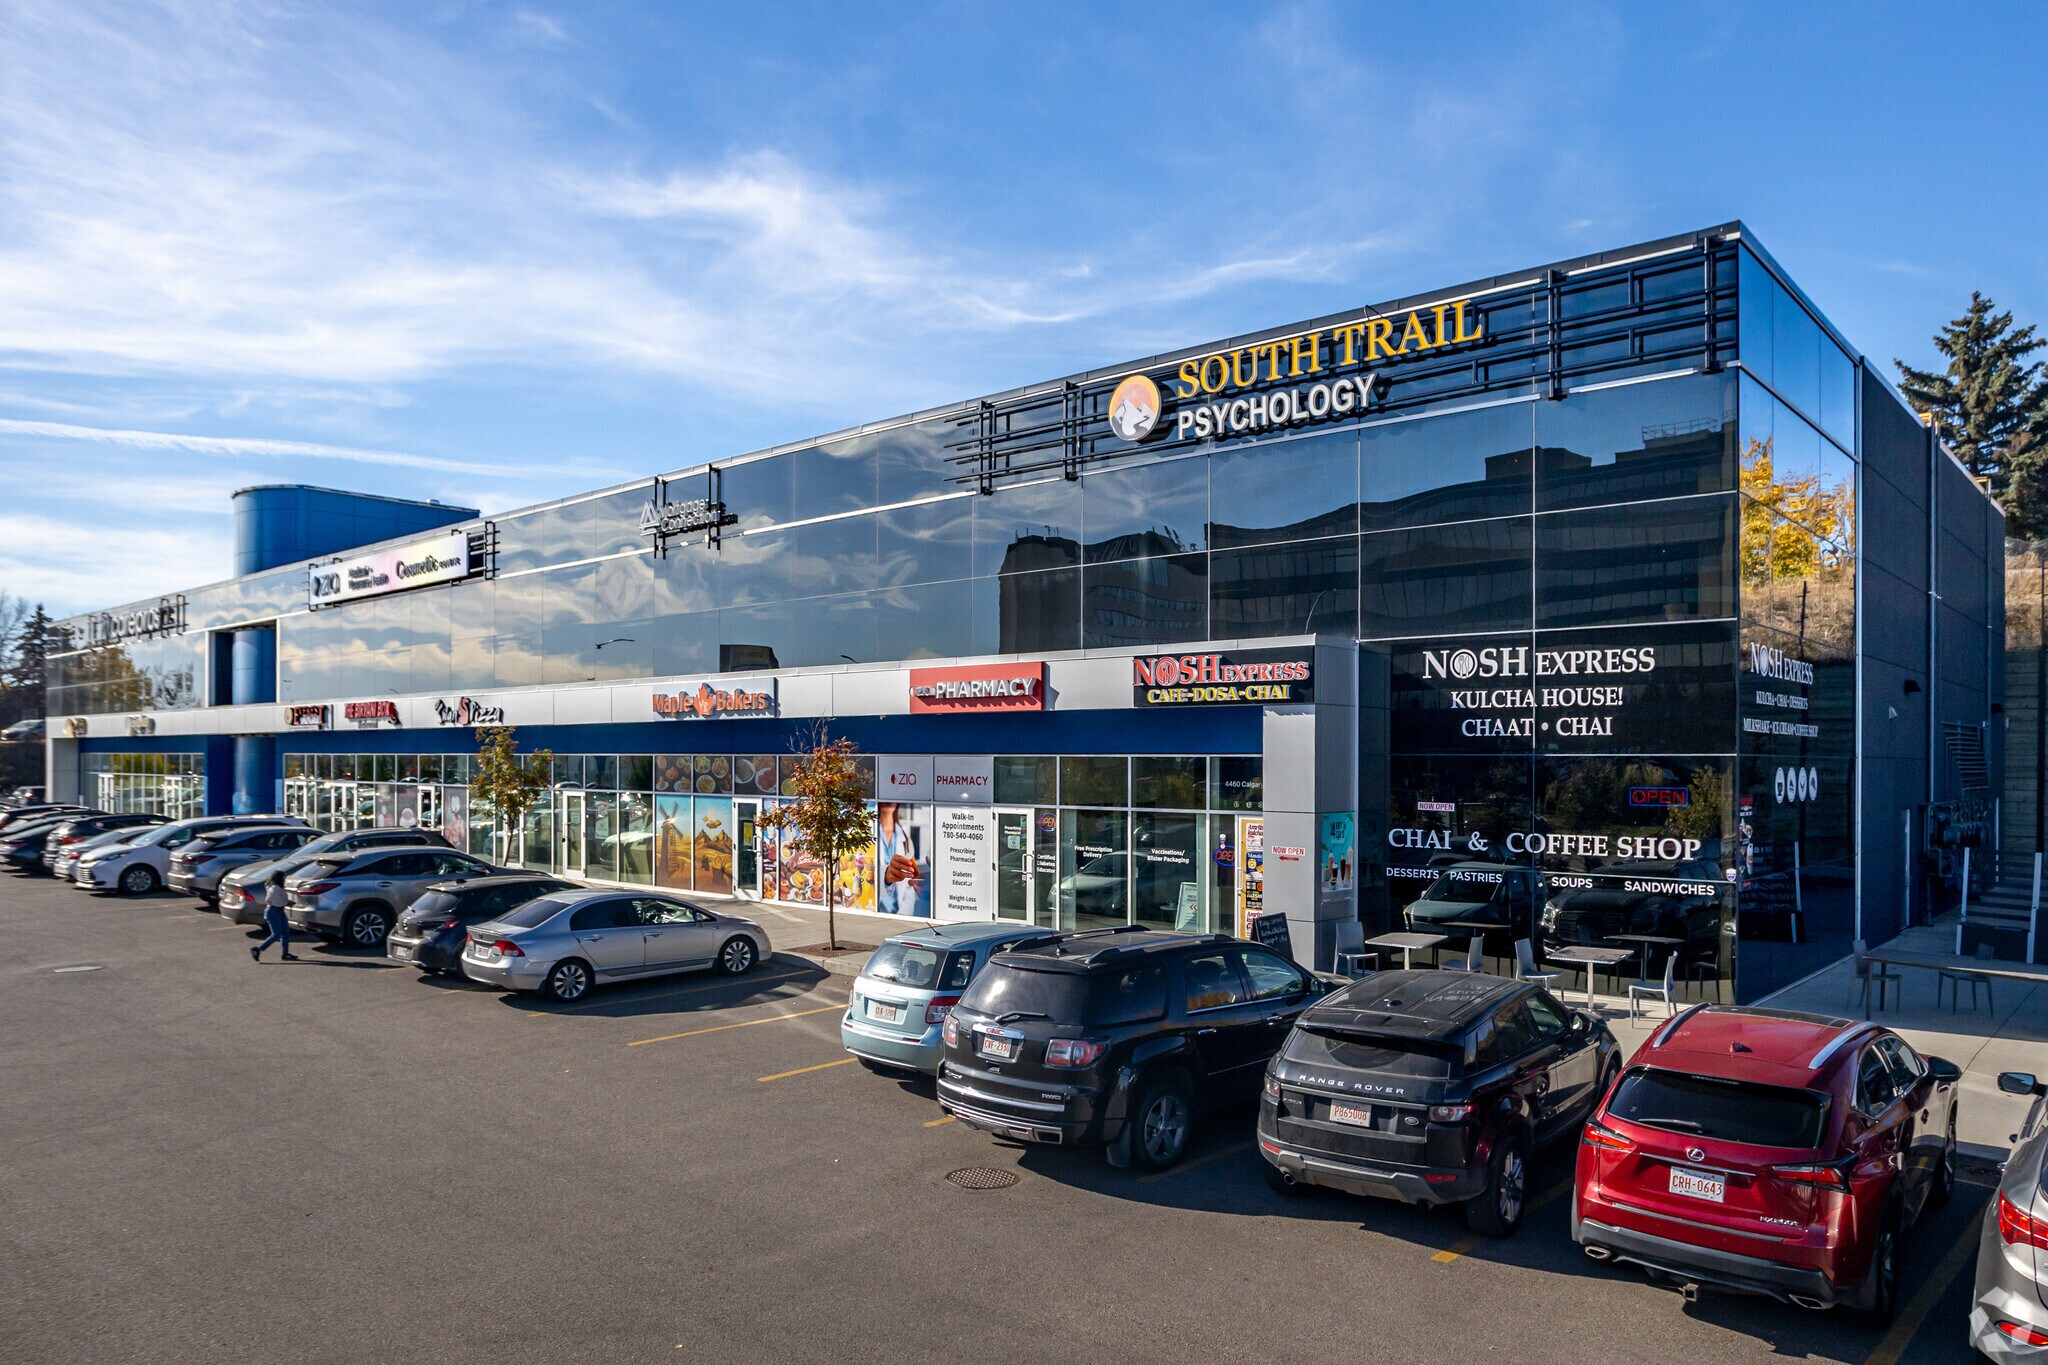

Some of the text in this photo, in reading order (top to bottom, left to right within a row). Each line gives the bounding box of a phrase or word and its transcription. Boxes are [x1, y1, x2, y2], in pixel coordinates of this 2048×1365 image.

[1177, 299, 1483, 399] SOUTH TRAIL
[1177, 373, 1377, 442] PSYCHOLOGY
[396, 555, 439, 579] Cosmetic
[1132, 654, 1311, 687] NOSH EXPRESS
[1422, 646, 1656, 679] NOSH EXPRESS
[1750, 641, 1814, 685] NOSH EXPRESS
[935, 677, 1036, 699] PHARMACY
[1451, 686, 1623, 709] KULCHA HOUSE!
[469, 700, 501, 723] Pizza
[652, 691, 691, 718] Maple
[715, 688, 767, 711] Bakers
[1461, 716, 1613, 737] CHAAT CHAI
[936, 775, 989, 787] PHARMACY
[1224, 780, 1241, 788] 4460
[1419, 802, 1453, 811] NOW OPEN
[1631, 789, 1685, 804] OPEN
[942, 821, 985, 832] Appointments
[951, 812, 975, 821] Walk-In
[942, 831, 984, 841] 780-540-4060
[1388, 828, 1701, 861] CHAI & COFFEE SHOP
[949, 847, 976, 856] Prescribing
[949, 855, 976, 863] Pharmacist
[1163, 857, 1190, 865] Packaging
[1272, 846, 1287, 854] NOW
[1287, 847, 1304, 856] OPEN
[952, 870, 973, 878] Diabetes
[1386, 867, 1715, 896] DESSERTS PASTRIES SOUPS SANDWICHES
[948, 903, 977, 912] Management
[1299, 1074, 1405, 1095] RANGE ROVER
[1672, 1174, 1722, 1196] CRH-0643
